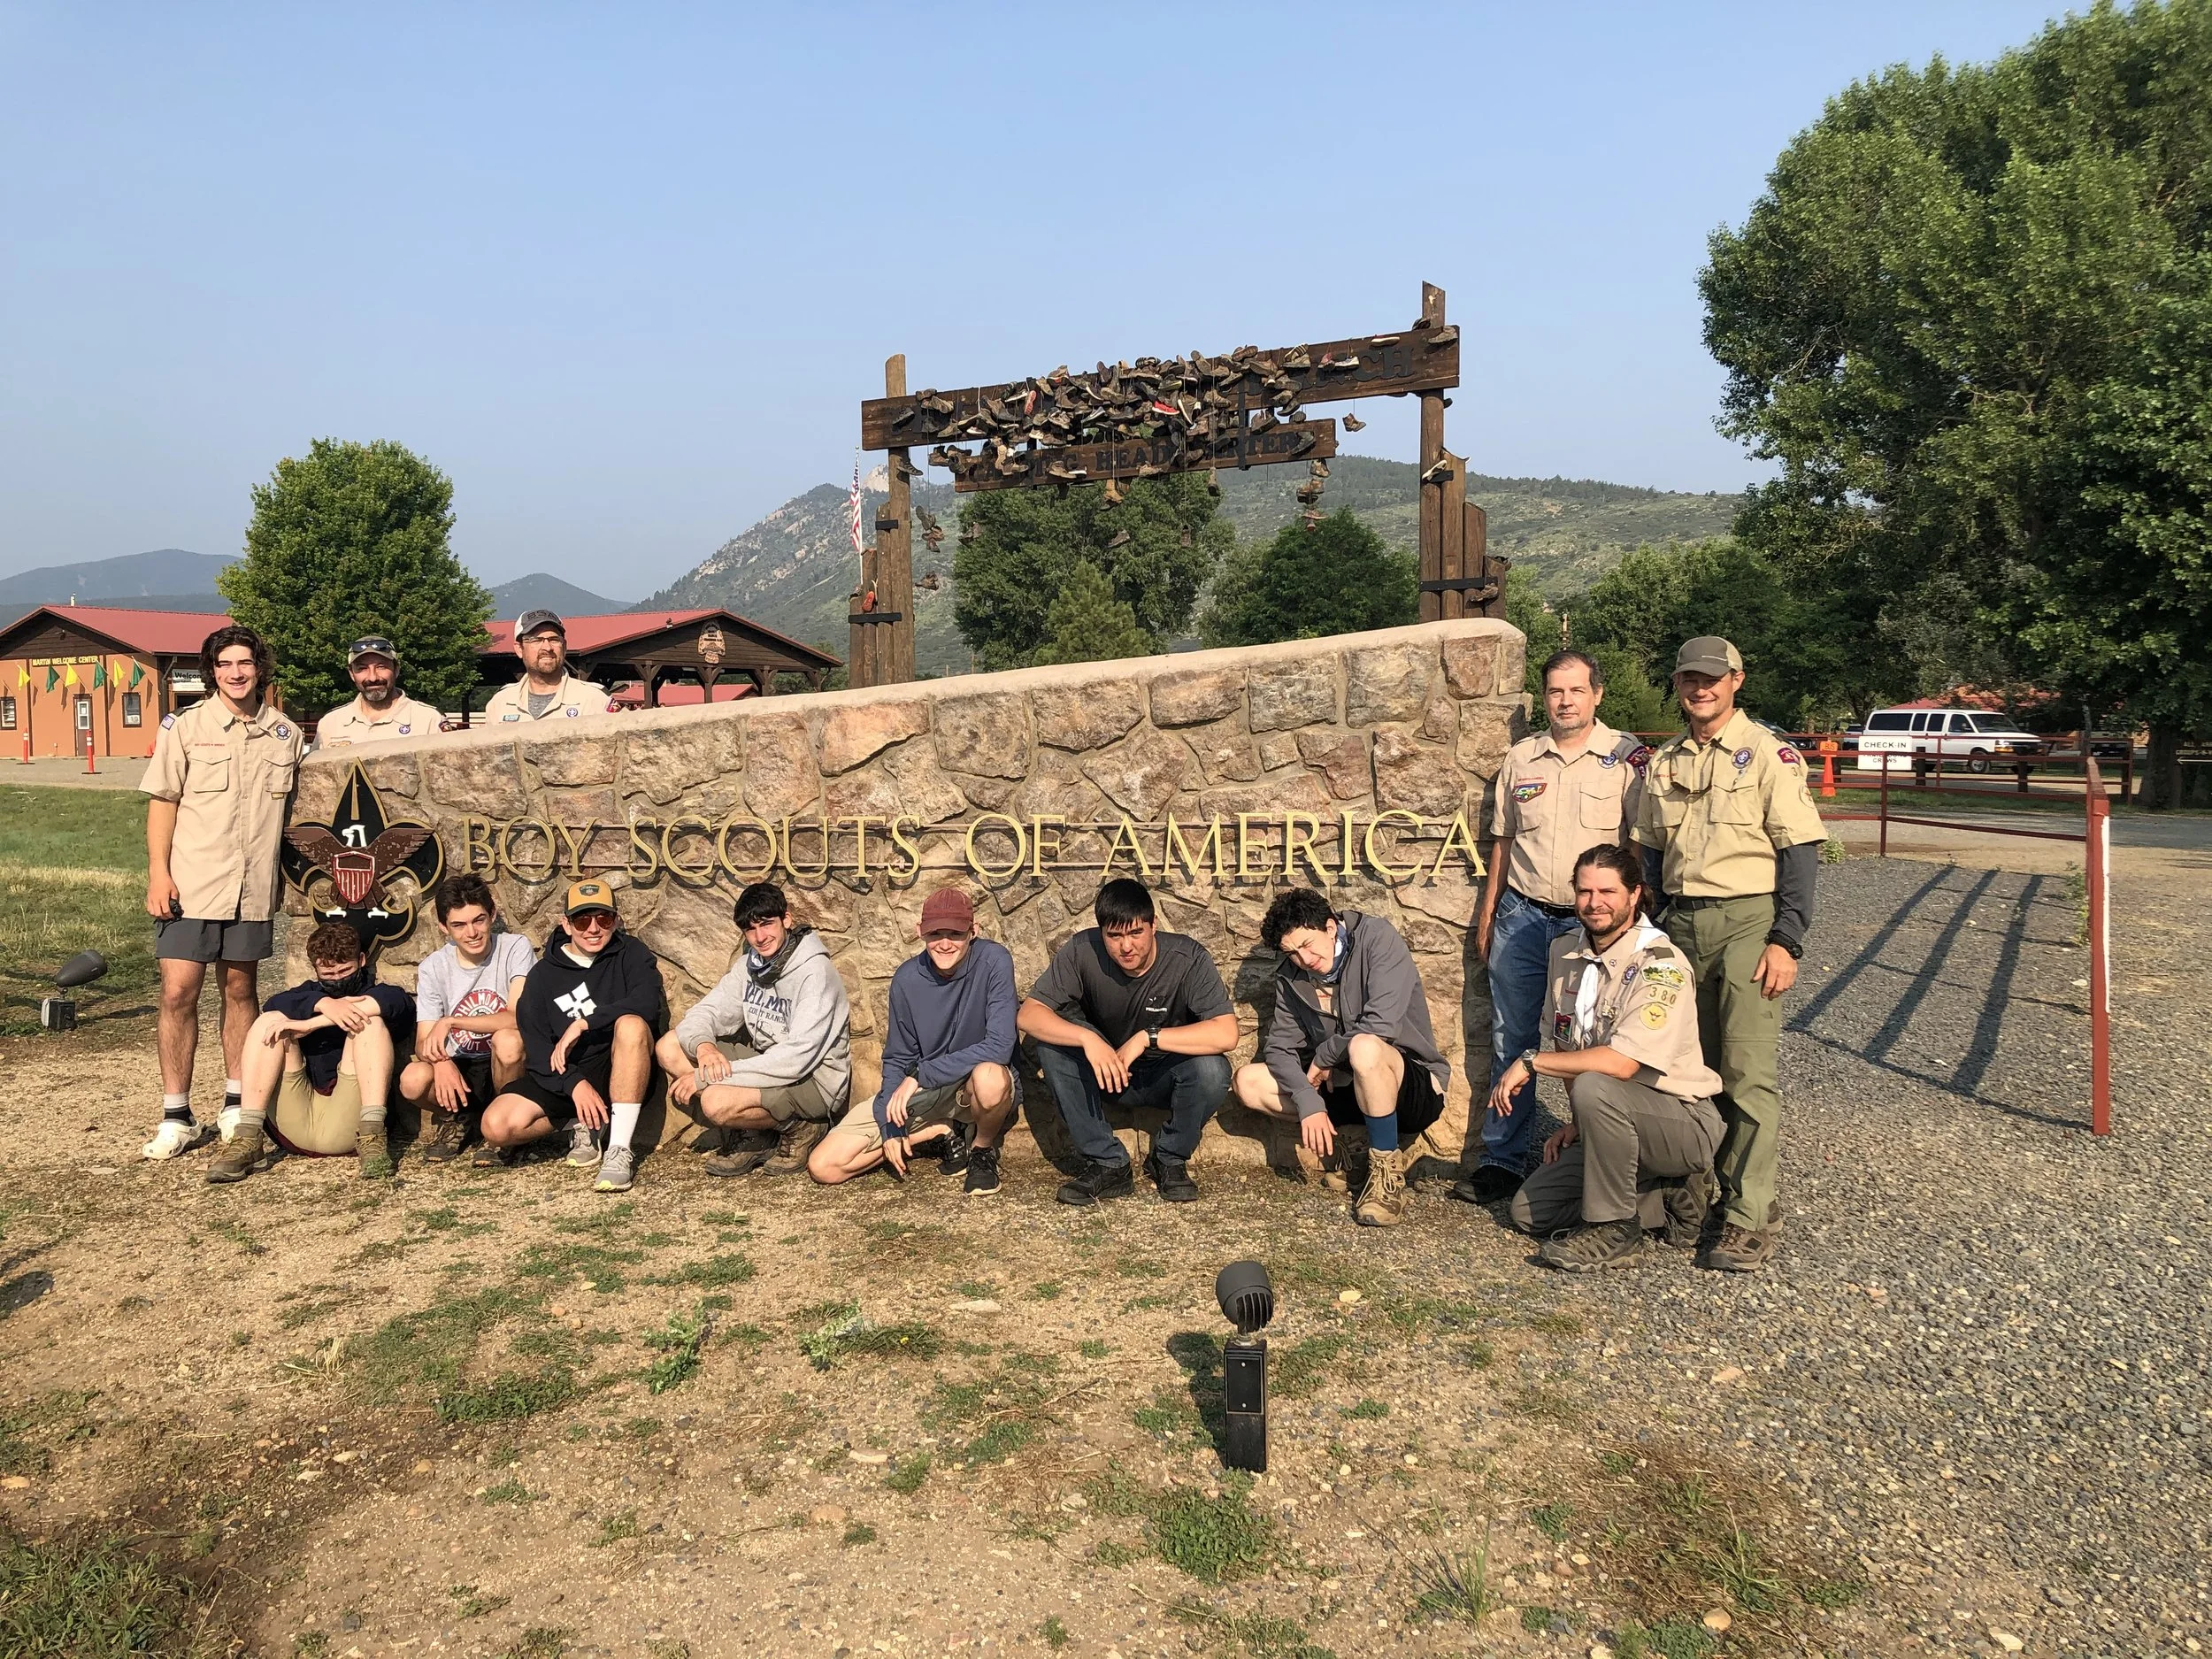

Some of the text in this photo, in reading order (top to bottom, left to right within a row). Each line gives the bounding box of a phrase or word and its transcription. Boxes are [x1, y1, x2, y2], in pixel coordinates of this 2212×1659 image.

[527, 611, 557, 620] BSA
[461, 810, 1488, 879] BOY SCOUTS OF AMERICA
[1649, 987, 1677, 1005] 380
[455, 1029, 480, 1051] SCOUT
